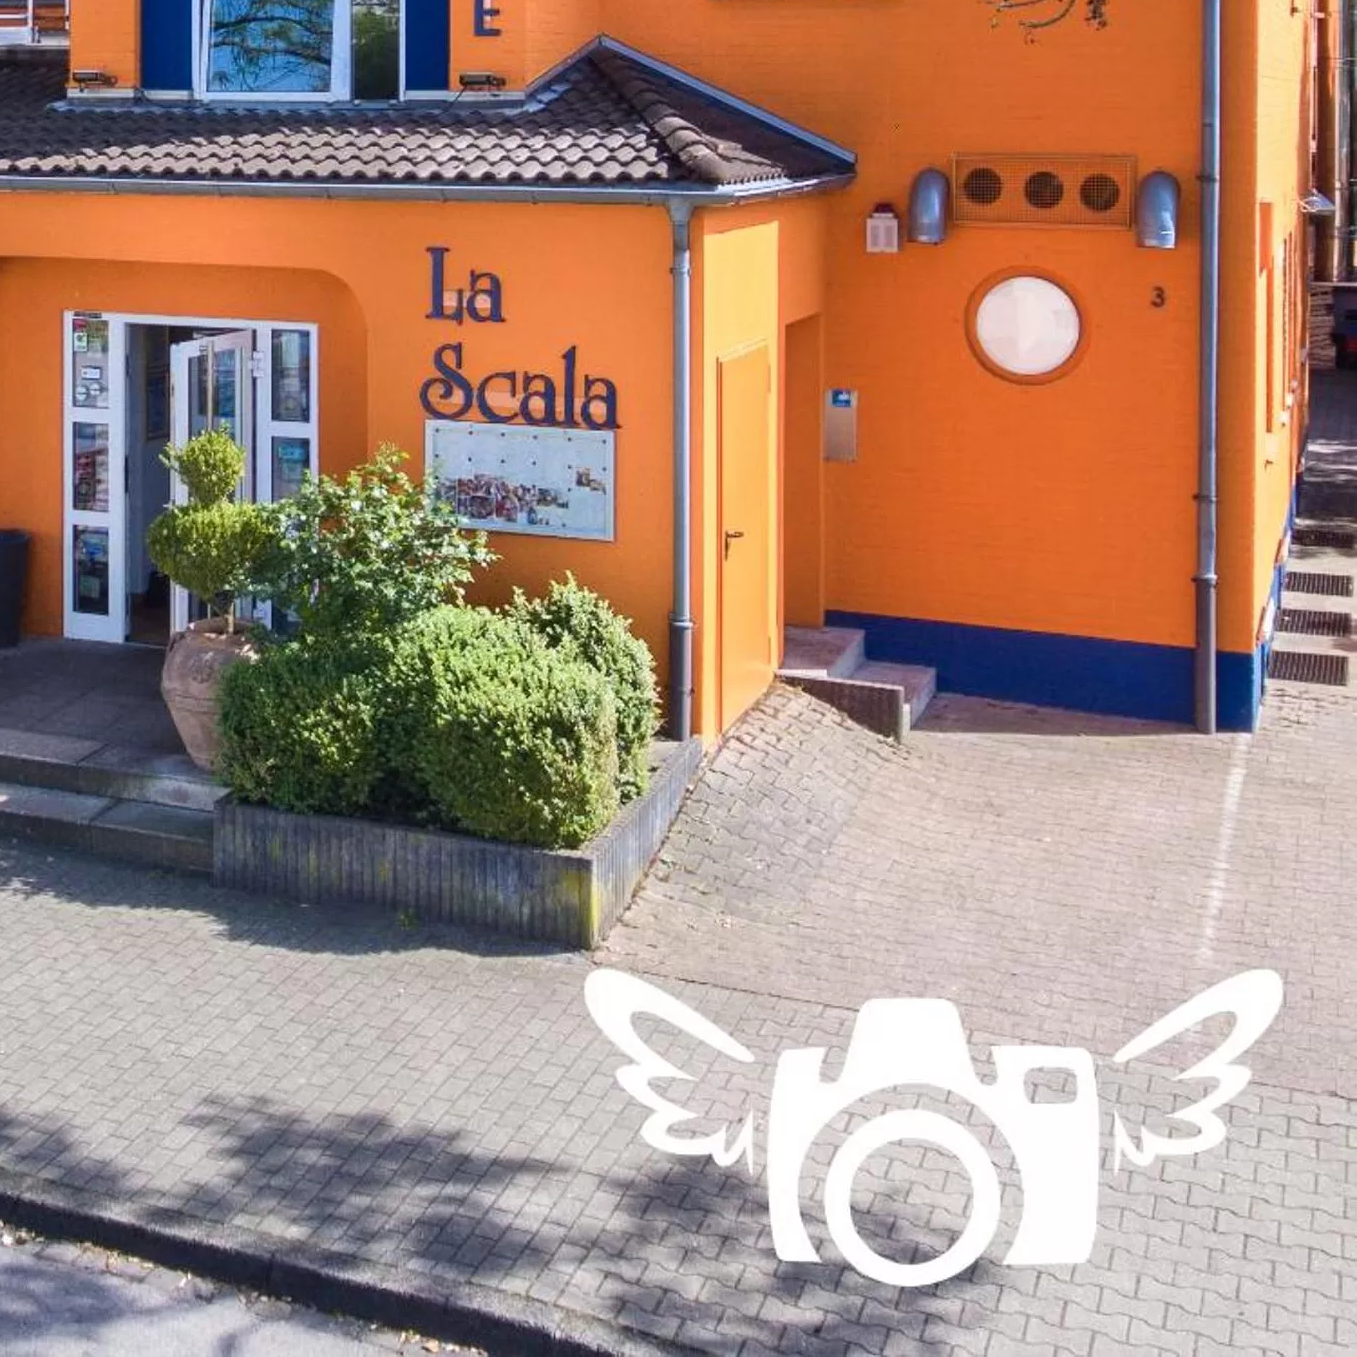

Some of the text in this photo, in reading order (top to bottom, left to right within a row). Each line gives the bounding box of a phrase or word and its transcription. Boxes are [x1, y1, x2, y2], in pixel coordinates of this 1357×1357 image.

[425, 246, 506, 325] La
[1150, 286, 1165, 308] 3
[419, 341, 622, 430] Scala
